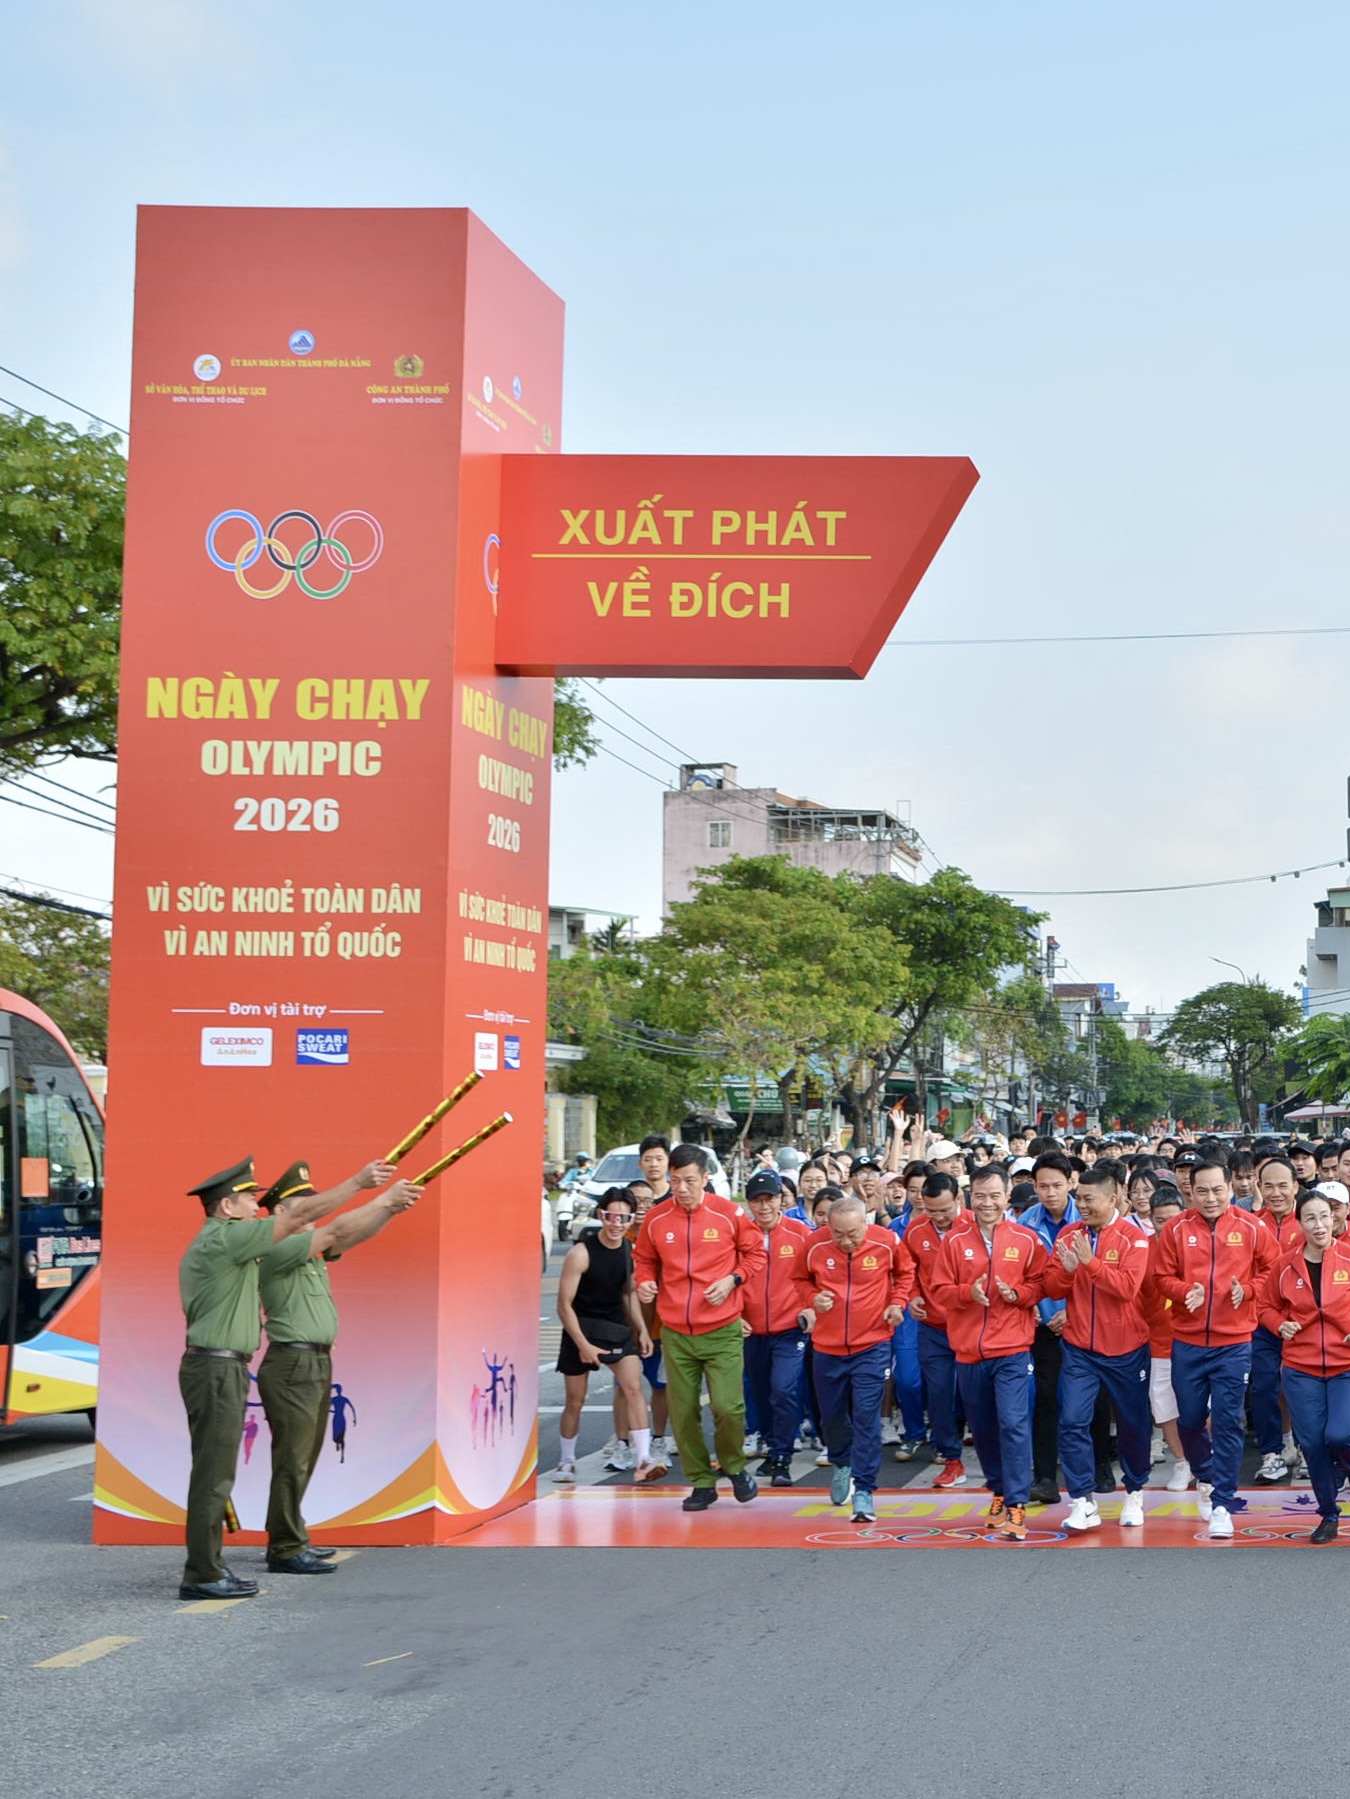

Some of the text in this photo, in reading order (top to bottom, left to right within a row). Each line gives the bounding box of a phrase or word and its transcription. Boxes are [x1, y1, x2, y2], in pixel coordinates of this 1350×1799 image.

[558, 494, 847, 546] XUẤT PHÁT
[587, 566, 791, 618] VỀ ĐÍCH
[146, 671, 431, 728] NGÀY CHẠY
[461, 684, 548, 762] NGÀY CHẠY
[201, 739, 382, 776] OLYMPIC
[478, 754, 534, 805] OLYMPIC
[233, 797, 340, 832] 2026
[487, 813, 521, 853] 2026
[147, 879, 421, 914] VÌ SỨC KHOẺ TOÀN DÂN
[164, 922, 401, 960] VÌ AN NINH TỔ QUỐC
[229, 1002, 327, 1018] Đơn vị tài trợ
[210, 1037, 264, 1045] GELEXIMCO
[297, 1034, 348, 1044] POCARI
[297, 1043, 343, 1052] SWEAT
